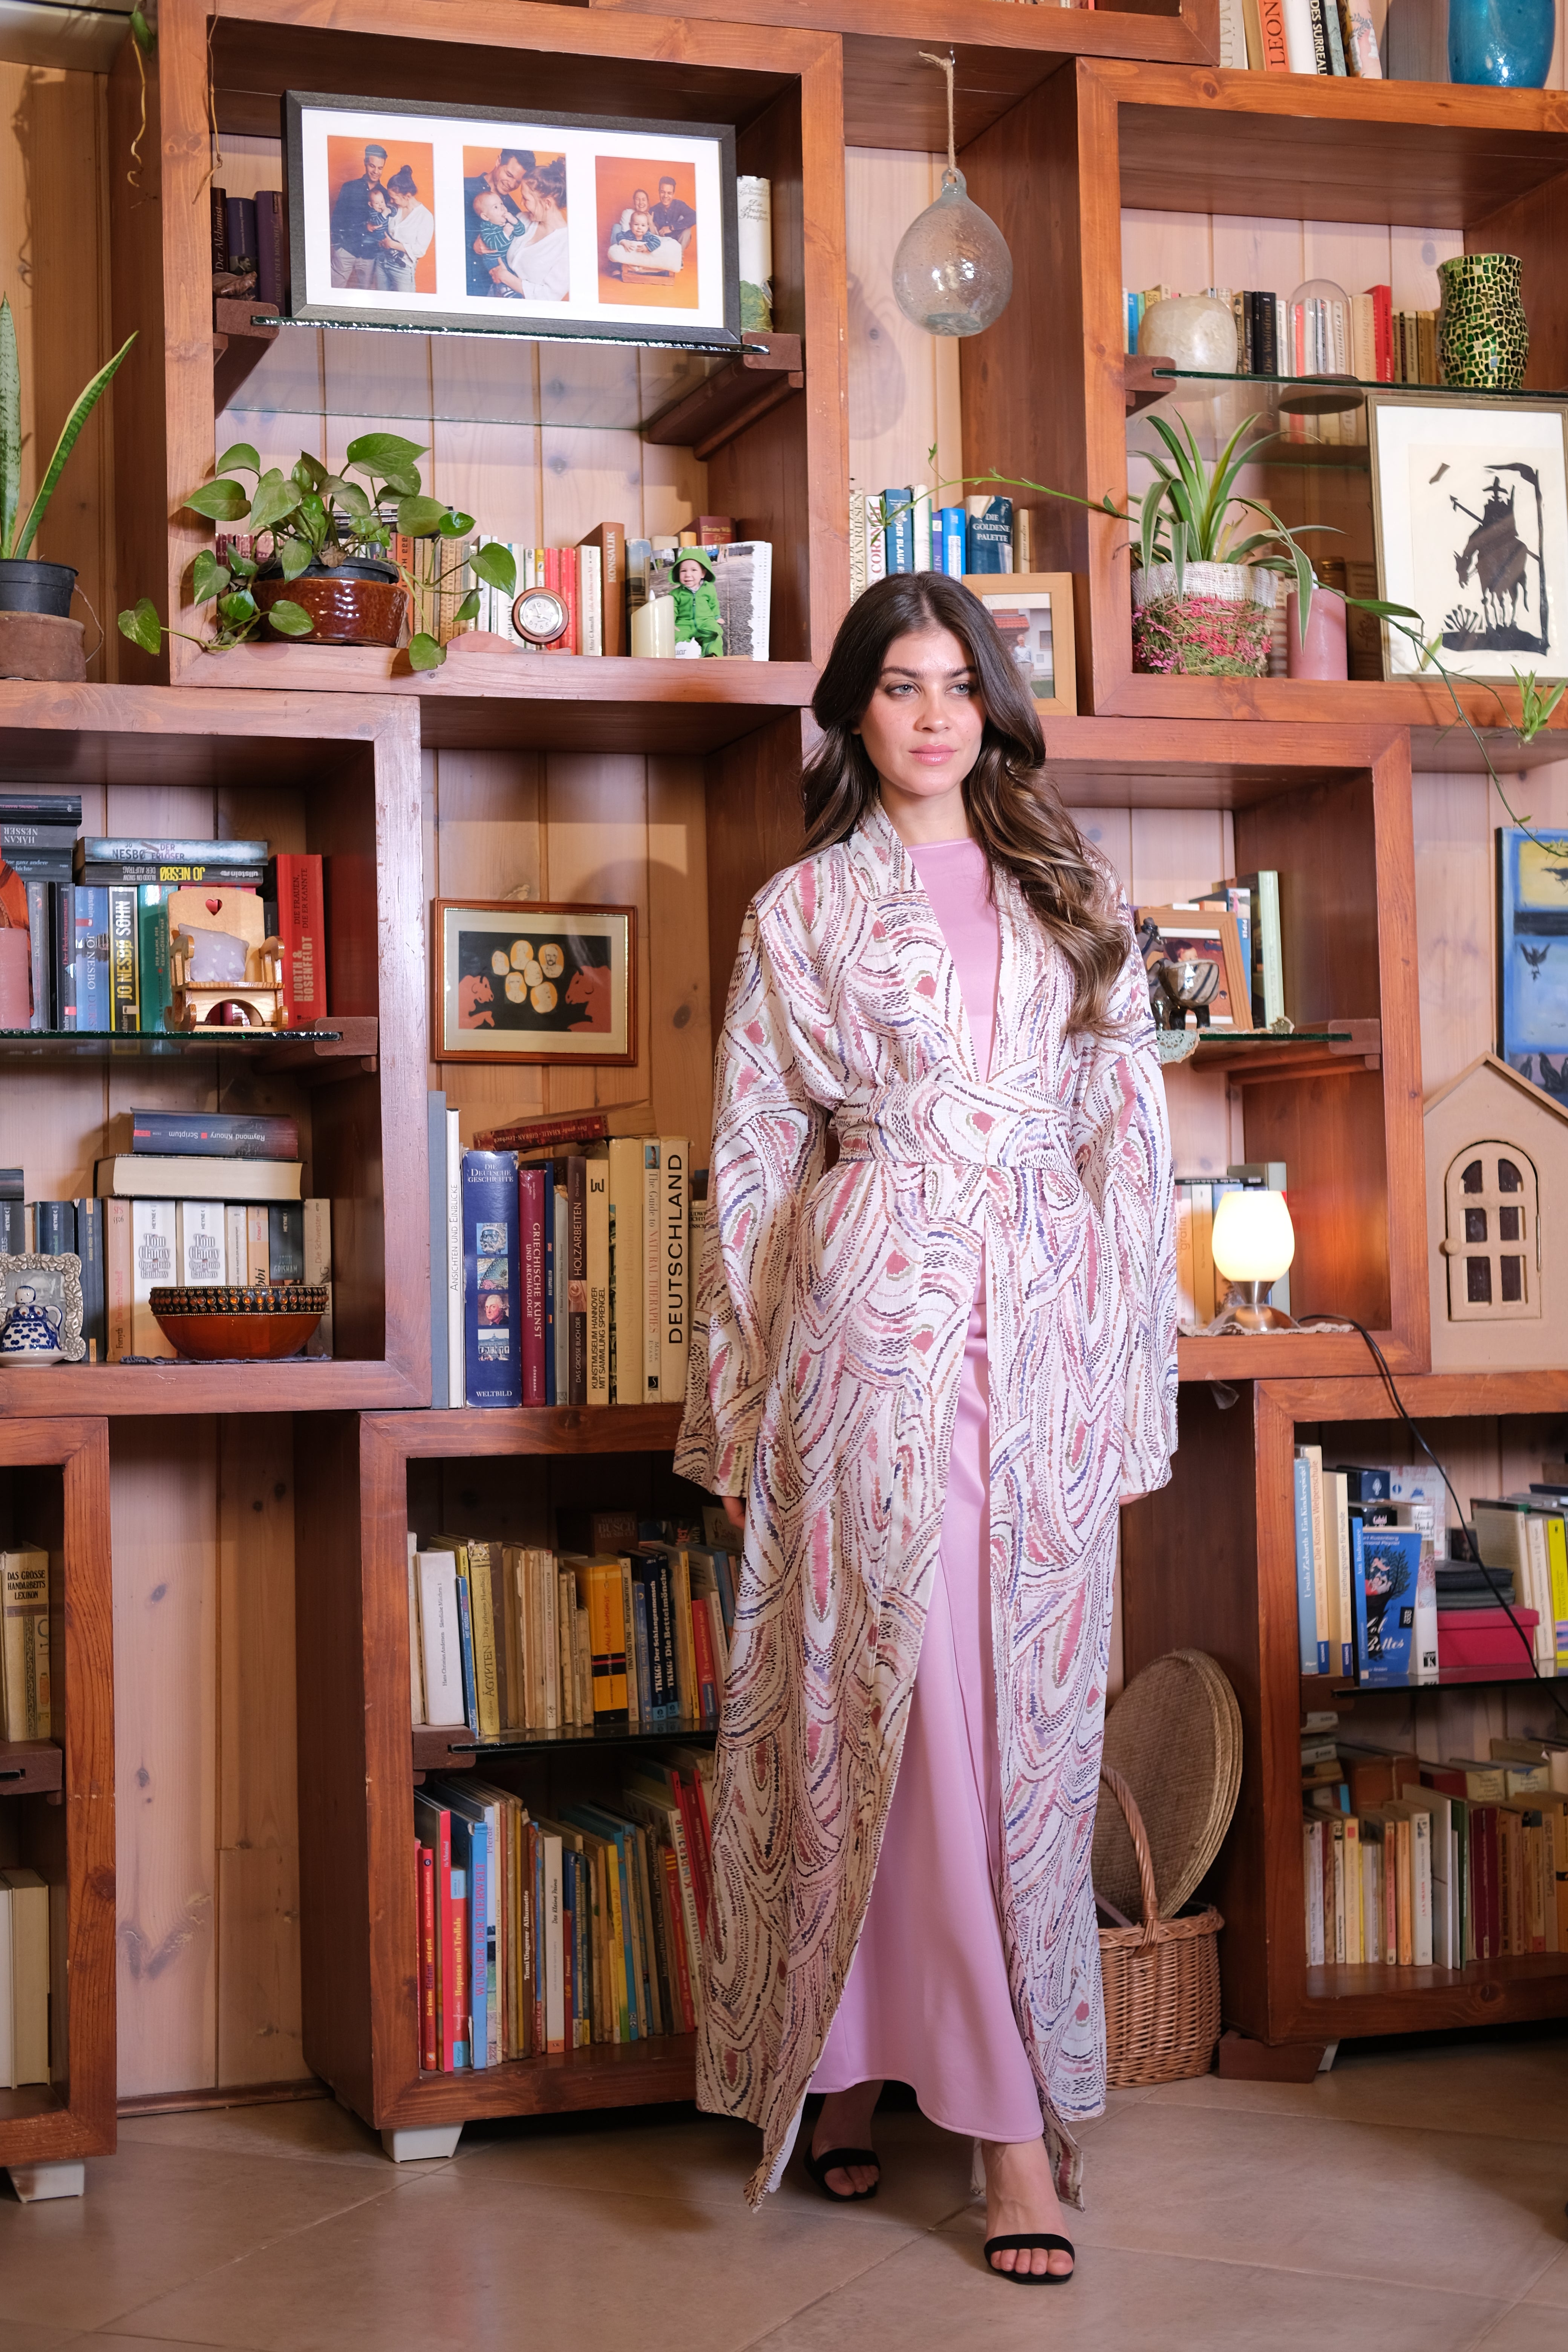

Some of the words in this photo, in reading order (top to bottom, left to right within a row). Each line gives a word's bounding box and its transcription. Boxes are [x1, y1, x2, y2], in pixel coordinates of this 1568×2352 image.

[214, 206, 223, 249] Alchimist
[1264, 355, 1272, 372] Die
[972, 523, 1011, 533] GOLDENE
[985, 513, 999, 522] DIE
[853, 488, 864, 582] OZEANRIESEN
[977, 533, 1009, 542] PALETTE
[606, 531, 617, 583] KONSALIK
[896, 539, 905, 564] BLAUE
[4, 827, 38, 836] NESSER
[5, 836, 35, 845] HÅKAN
[152, 851, 185, 861] ERLÖSER
[160, 843, 176, 851] DER
[160, 867, 191, 881] NESBØ
[193, 867, 205, 881] JO
[115, 901, 132, 936] SOHN
[302, 909, 308, 917] ER
[87, 932, 95, 948] JO
[115, 939, 133, 983] NESBØ
[292, 949, 302, 959] &
[87, 951, 96, 990] NESBØ
[302, 936, 314, 1002] ROSENFELDT
[292, 961, 304, 1002] HJORTH
[117, 985, 133, 1000] JO
[210, 1132, 233, 1140] Khoury
[649, 1171, 658, 1188] The
[649, 1190, 658, 1216] Guide
[144, 1233, 166, 1247] Tom
[193, 1233, 215, 1247] Tom
[574, 1202, 582, 1276] HOLZARBEITEN
[668, 1155, 683, 1344] DEUTSCHLAND
[138, 1245, 170, 1260] Clancy
[188, 1245, 219, 1259] Clancy
[278, 1256, 292, 1265] JOHN
[533, 1222, 541, 1297] GRIECHISCHE
[649, 1230, 658, 1276] NATURAL
[139, 1260, 171, 1273] Operation
[189, 1260, 220, 1273] Operation
[274, 1265, 298, 1274] GRISHAM
[649, 1279, 658, 1334] THERAPIES
[534, 1302, 542, 1339] KUNST
[1299, 1465, 1308, 1516] Kinderspiegel
[1311, 1460, 1321, 1515] Welpenschule
[598, 1522, 635, 1533] BUSCH
[8, 1571, 19, 1580] DAS
[21, 1570, 45, 1580] GROSSE
[1340, 1545, 1348, 1598] Erziehungsspiele
[8, 1580, 46, 1590] HANDARBEITS
[15, 1591, 38, 1600] LEXIKON
[1303, 1573, 1312, 1598] Ursula
[650, 1580, 659, 1648] Schlangenmensch
[660, 1568, 671, 1639] Bettelmönche
[1367, 1636, 1404, 1652] Bettes
[482, 1645, 495, 1697] ÄGYPTEN
[675, 1819, 693, 1889] KINDERJAHR
[475, 1863, 485, 1919] TIERWELT
[453, 1917, 462, 1945] Trallala
[475, 1922, 485, 1943] DER
[686, 1893, 703, 1962] RAVENSBURGER
[455, 1965, 464, 1996] Hopsasa
[475, 1948, 485, 1997] WUNDER
